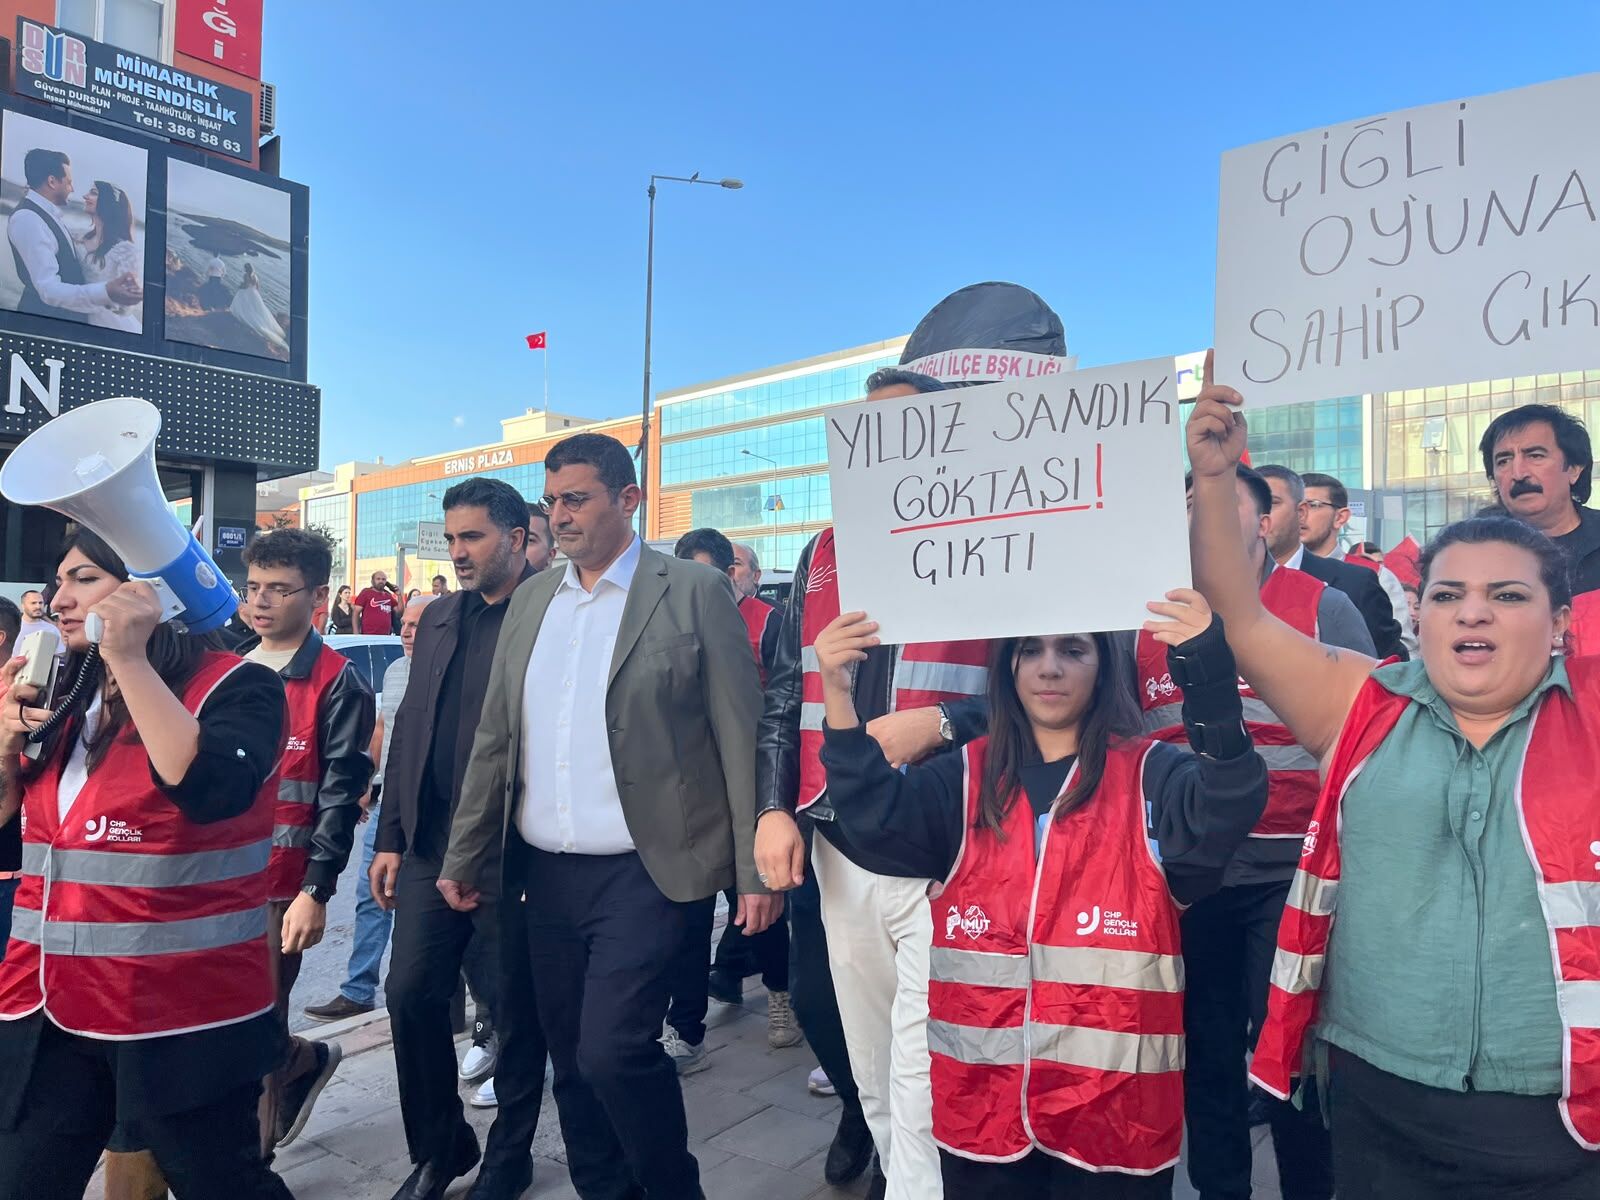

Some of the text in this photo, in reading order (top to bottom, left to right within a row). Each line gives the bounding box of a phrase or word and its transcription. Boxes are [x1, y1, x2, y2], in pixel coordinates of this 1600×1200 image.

[203, 0, 236, 59] Ğİ
[116, 53, 219, 100] MİMARLIK
[34, 79, 111, 109] Güven DURSUN
[91, 84, 111, 98] PLAN
[116, 92, 140, 106] PROJE
[95, 66, 237, 125] MÜHENDİSLİK
[66, 99, 102, 115] Mühendisi
[133, 111, 241, 153] Tel: 386 58 63
[1262, 102, 1467, 217] ÇİĞLİ
[1242, 286, 1425, 384] SAHİP
[948, 351, 982, 380] İLÇE
[985, 354, 1022, 380] BŞK
[831, 375, 1171, 469] YILDIZ SANDIK
[477, 449, 514, 469] PLAZA
[109, 820, 127, 828] CHP
[109, 827, 143, 836] GENÇLİK
[107, 834, 141, 842] KOLLARI
[960, 918, 991, 931] UMUT
[1103, 910, 1122, 919] CHP
[1103, 918, 1138, 929] GENÇLİK
[1103, 927, 1138, 937] KOLLARI
